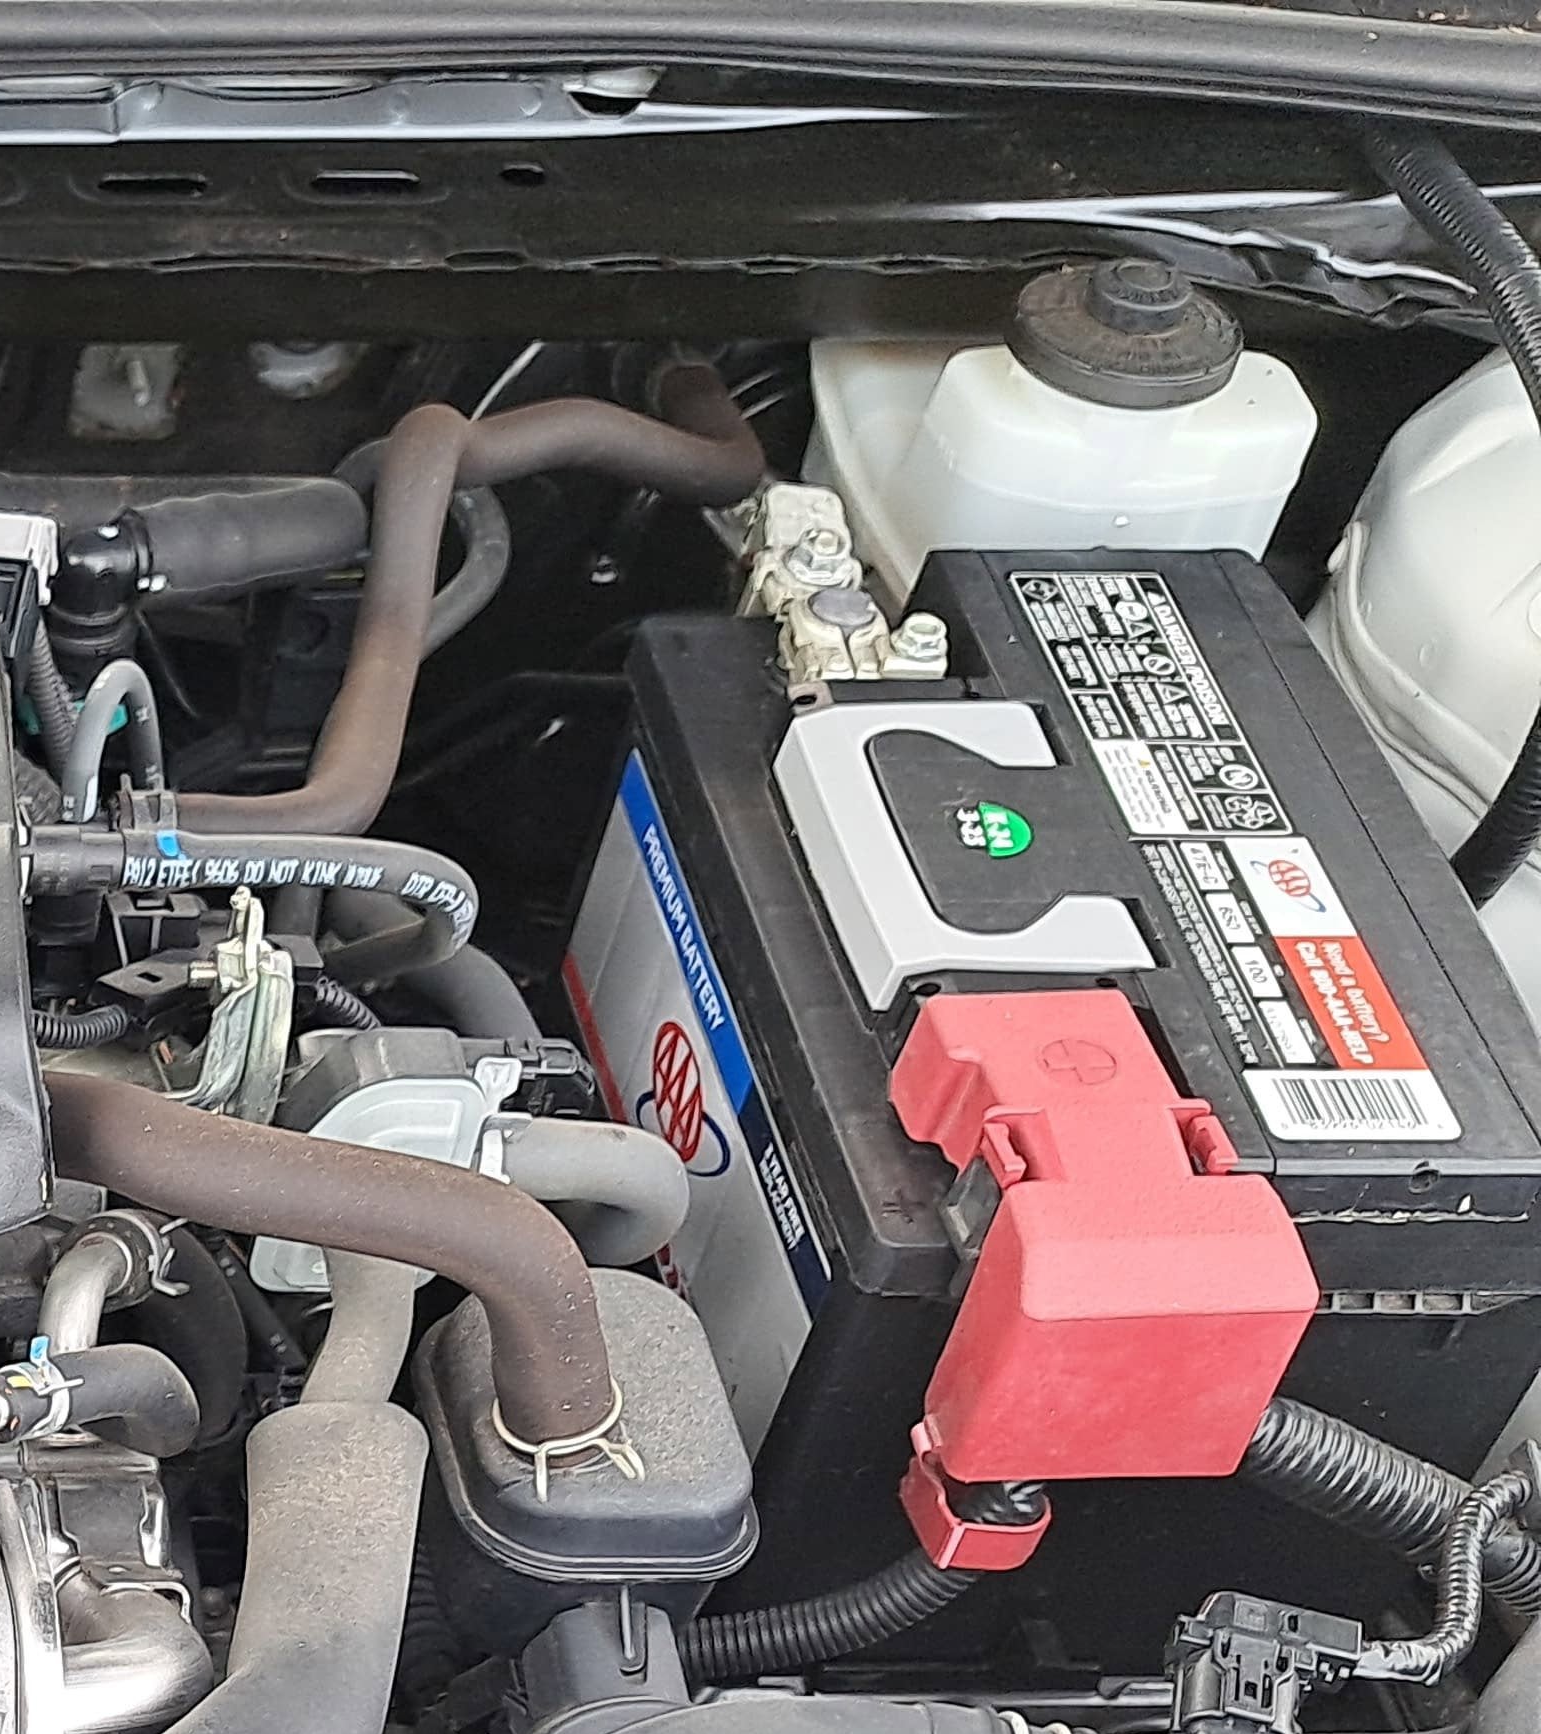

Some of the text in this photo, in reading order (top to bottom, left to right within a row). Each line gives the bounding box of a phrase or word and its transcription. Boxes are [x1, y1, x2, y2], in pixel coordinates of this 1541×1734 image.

[243, 858, 266, 884] DO
[268, 858, 299, 884] NOT
[300, 860, 343, 886] KINK
[642, 823, 724, 1030] PREMIUM BATTERY
[1295, 941, 1320, 967] Call
[1324, 942, 1352, 975] Need
